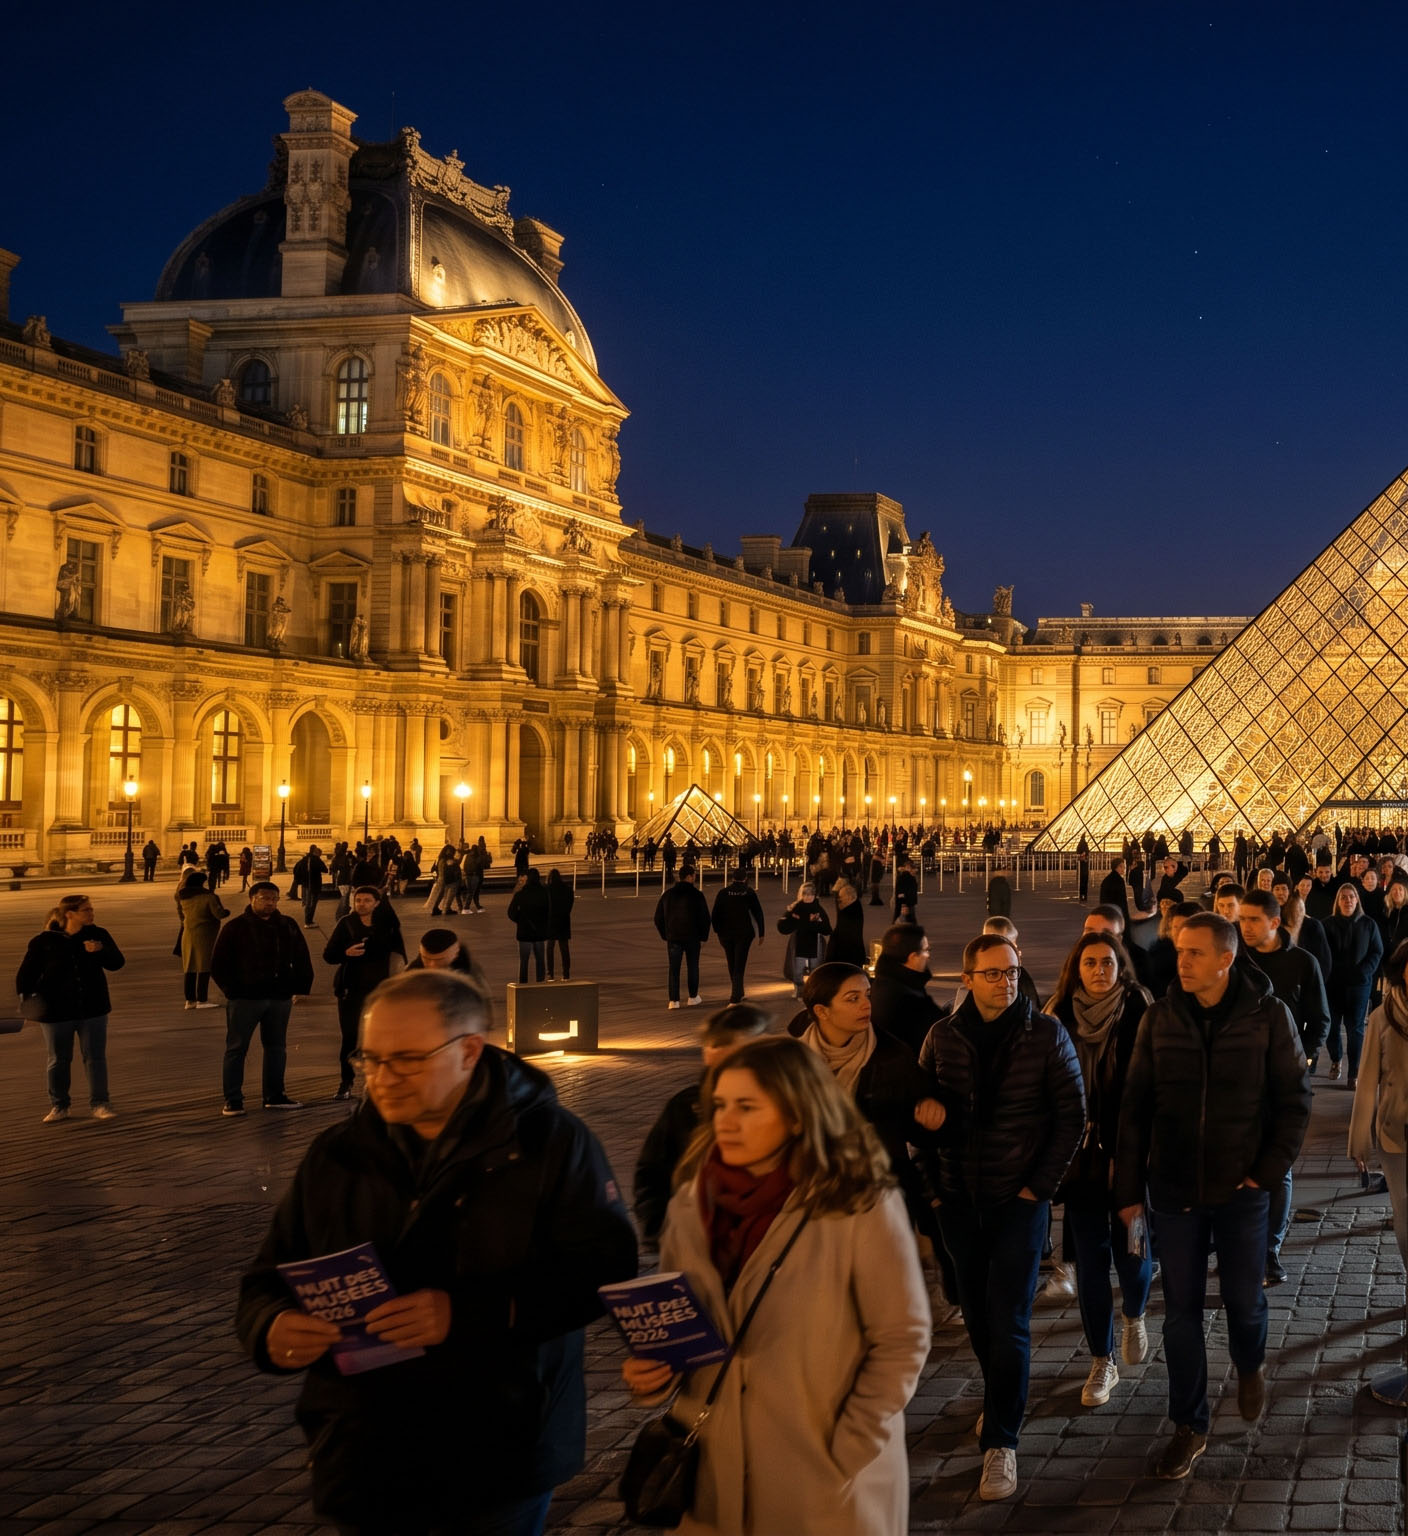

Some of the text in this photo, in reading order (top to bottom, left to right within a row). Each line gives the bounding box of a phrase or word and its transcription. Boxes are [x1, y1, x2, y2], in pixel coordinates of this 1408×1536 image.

[295, 1266, 382, 1297] NUIT DES
[613, 1296, 692, 1319] NUIT DES
[626, 1327, 670, 1345] 2026
